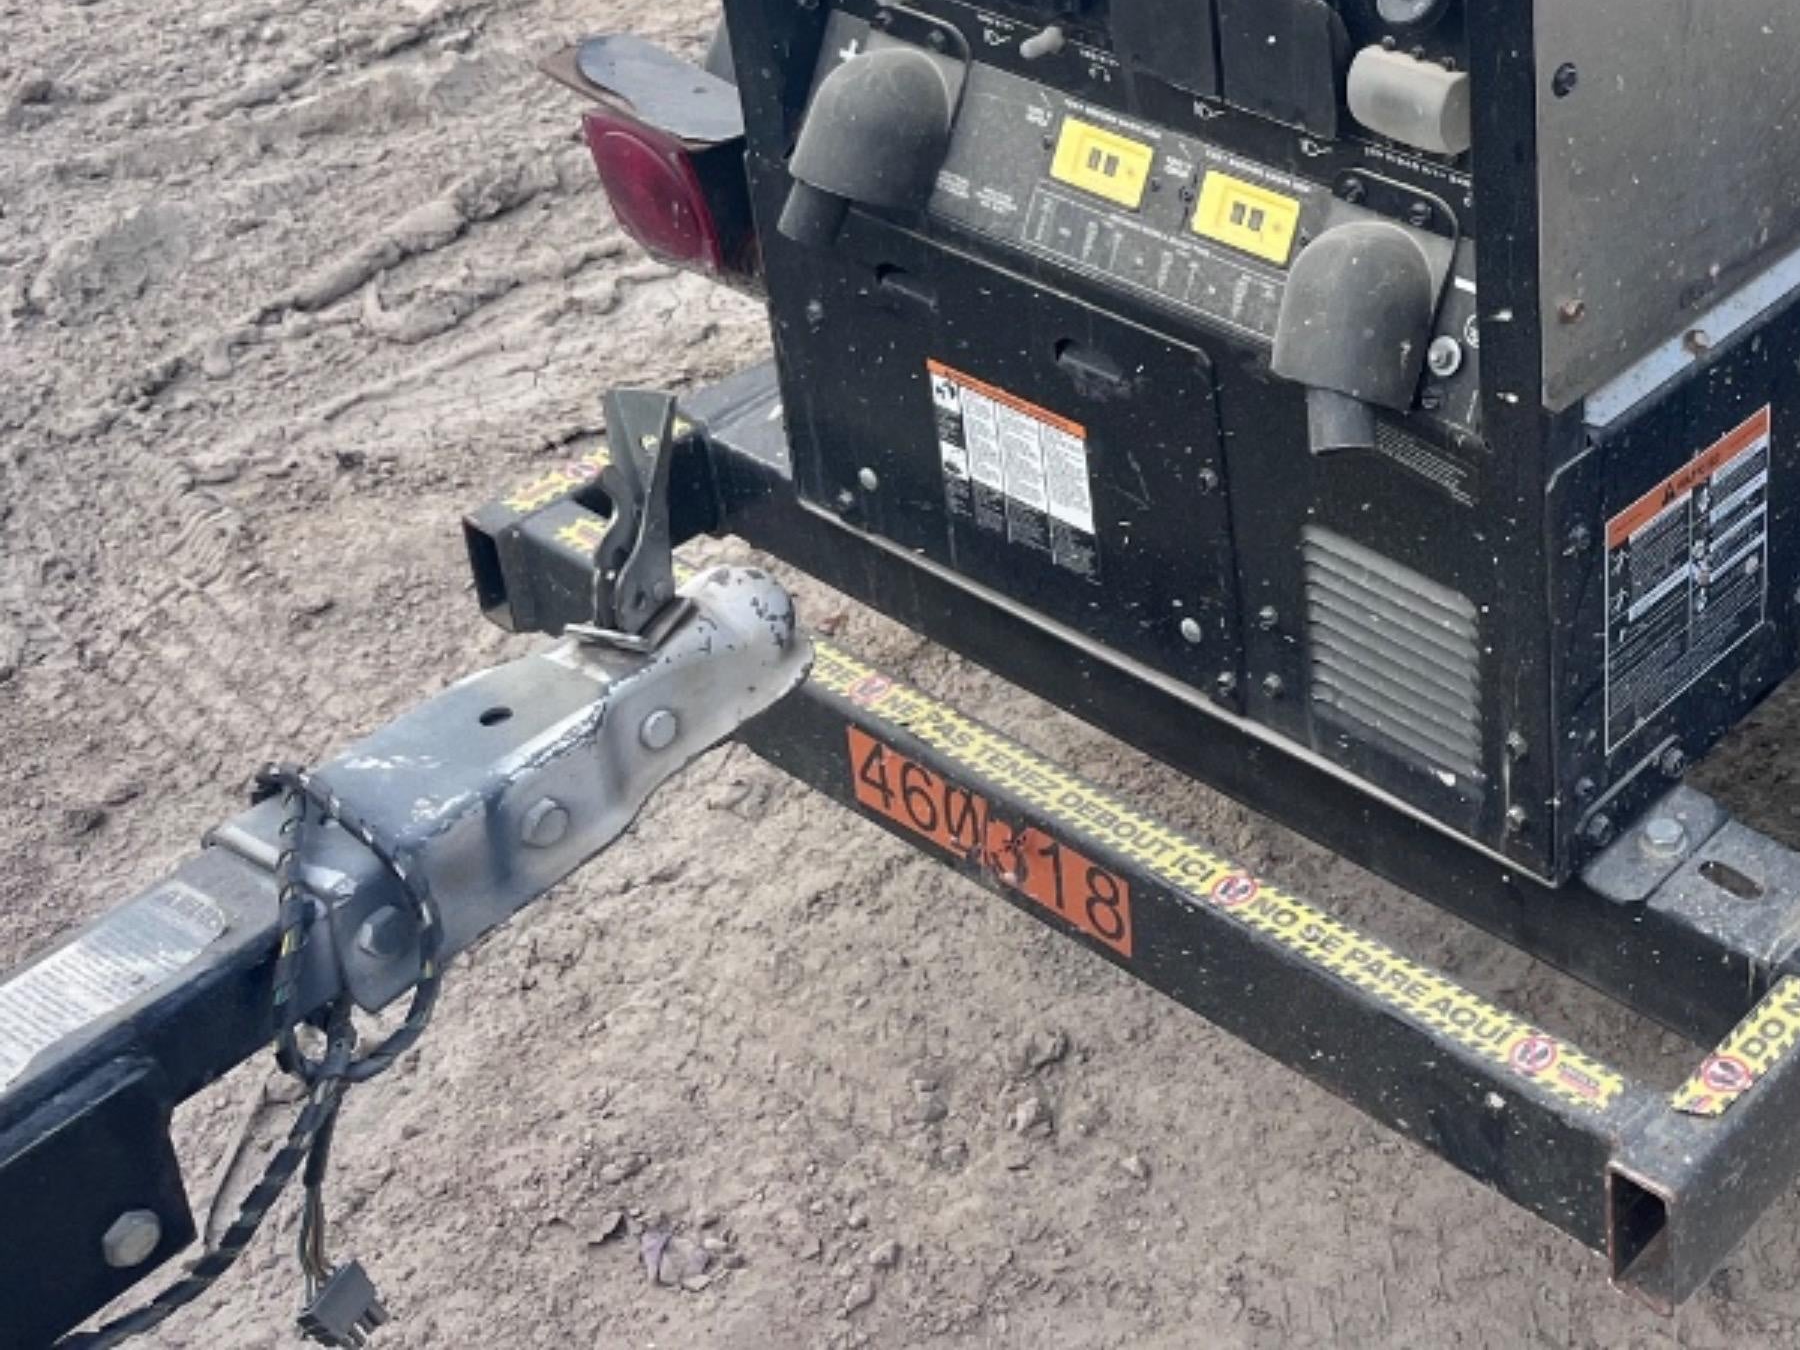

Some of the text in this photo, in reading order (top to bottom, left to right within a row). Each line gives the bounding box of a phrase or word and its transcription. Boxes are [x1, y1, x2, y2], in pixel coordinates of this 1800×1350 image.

[924, 708, 977, 756] PAS
[976, 739, 1062, 796] TENEZ
[1057, 789, 1180, 869] DEBOUT
[1245, 895, 1301, 928] NO
[1301, 922, 1347, 954] SE
[1342, 948, 1432, 1003] PARE
[1739, 1016, 1787, 1059] DO
